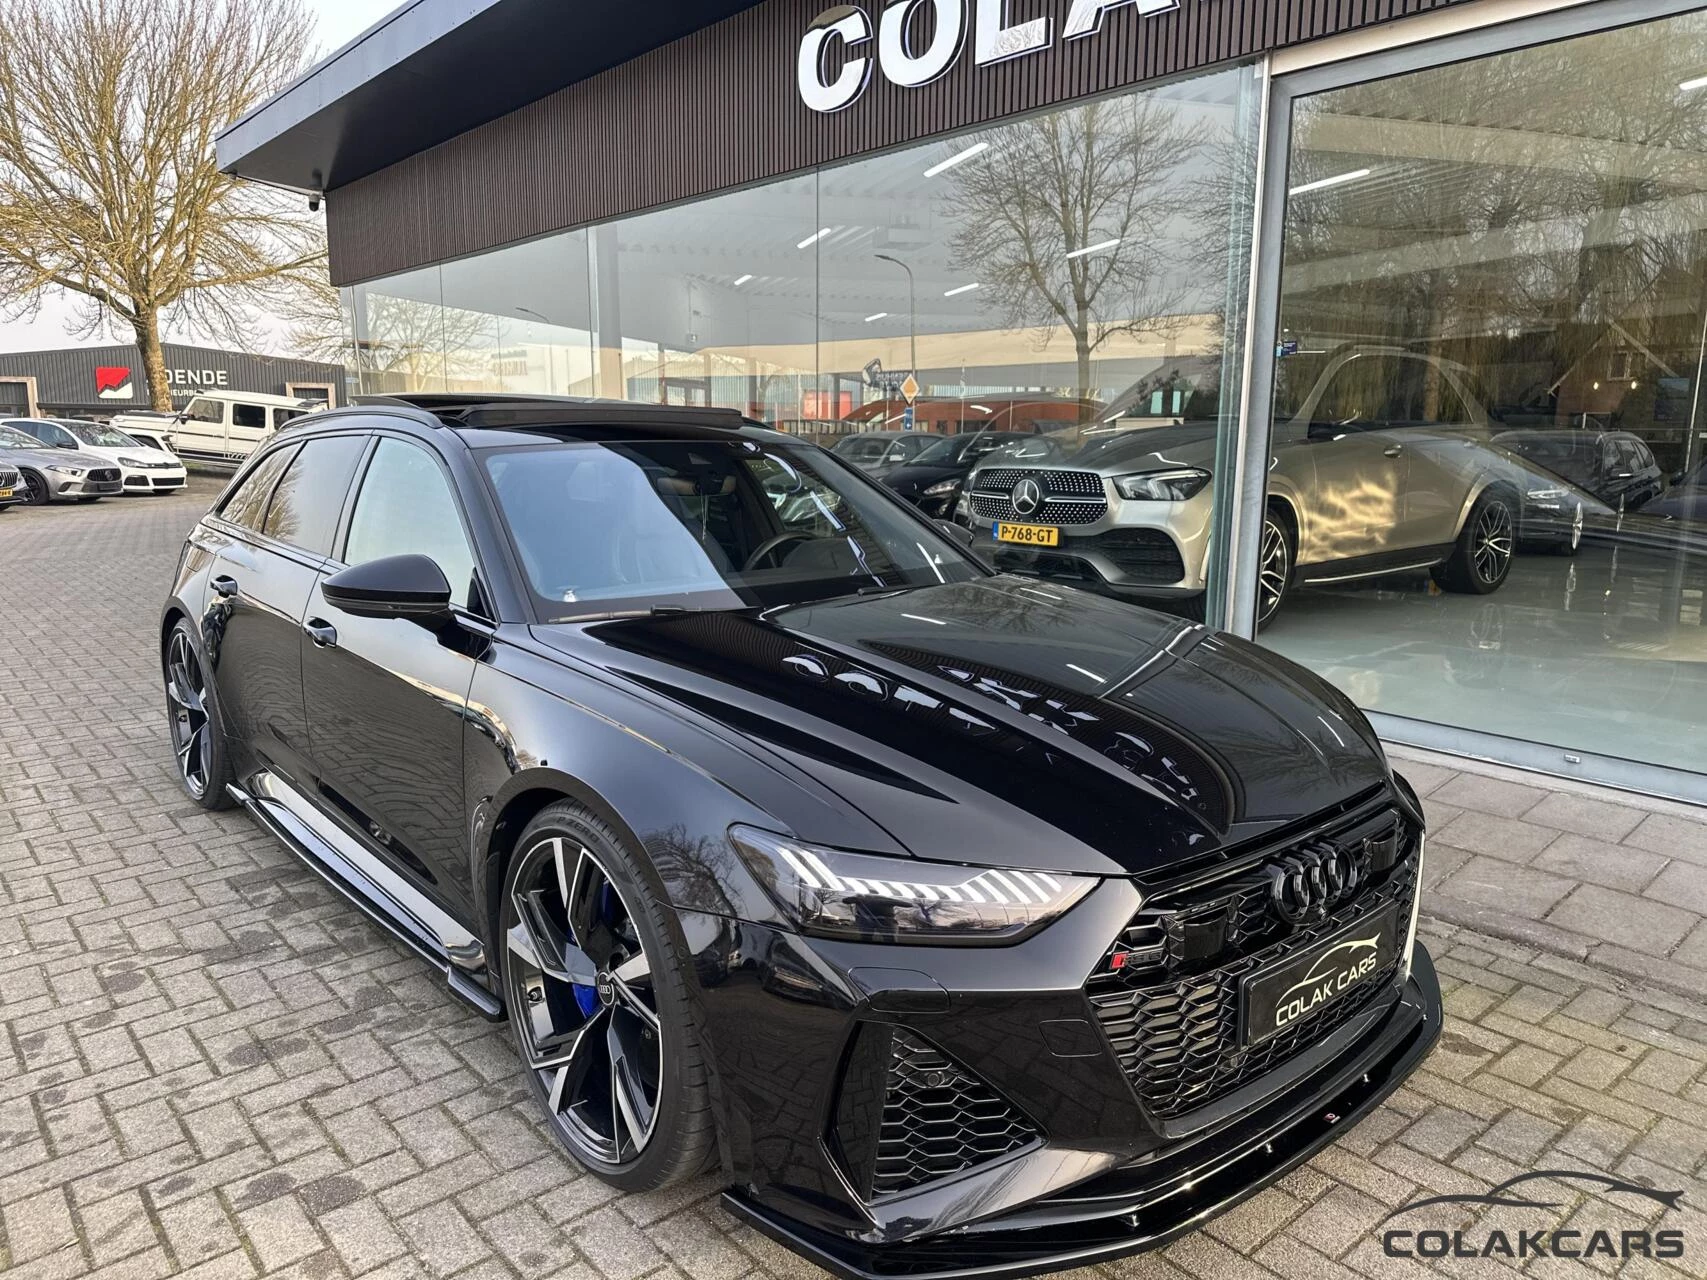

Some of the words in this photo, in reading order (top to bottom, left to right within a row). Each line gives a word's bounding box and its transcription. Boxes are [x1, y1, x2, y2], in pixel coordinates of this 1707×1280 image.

[1001, 525, 1054, 544] P-768-GT
[1275, 979, 1334, 1027] COLAK
[1336, 951, 1377, 991] CARS
